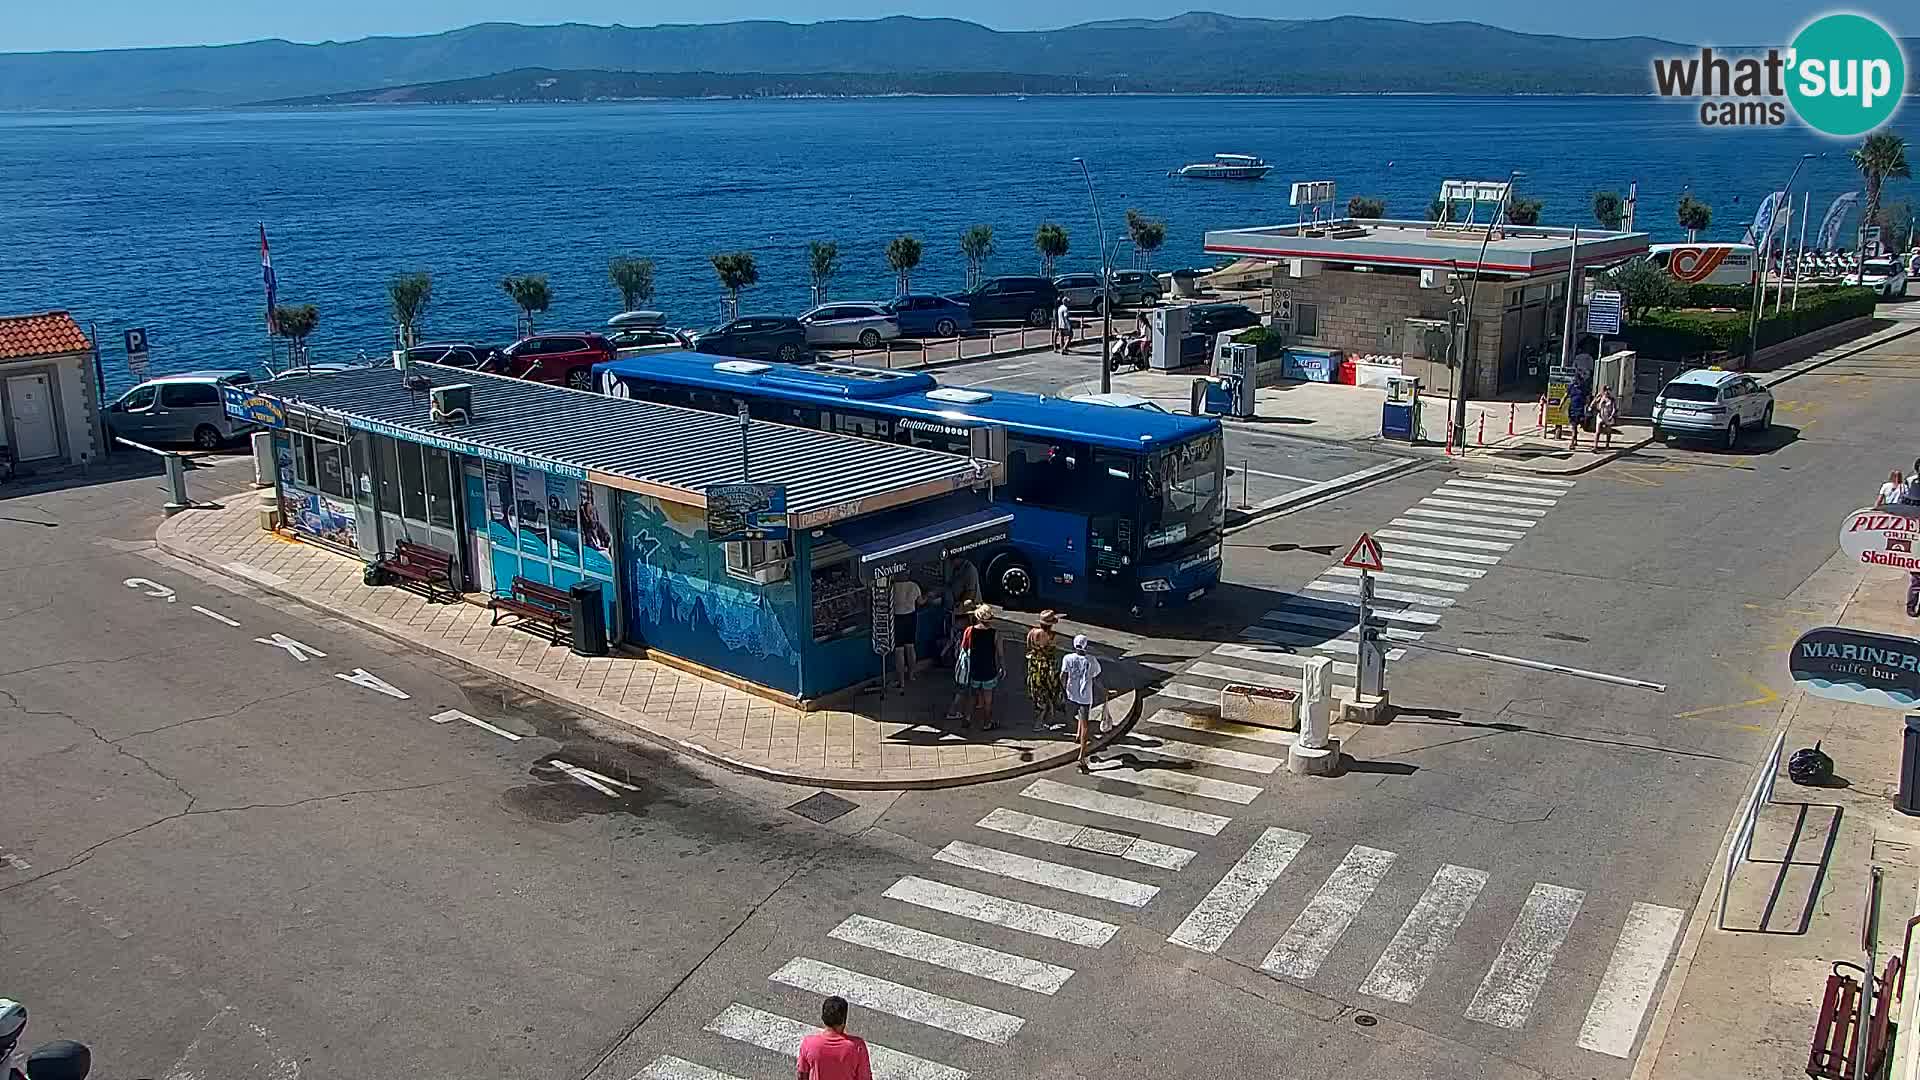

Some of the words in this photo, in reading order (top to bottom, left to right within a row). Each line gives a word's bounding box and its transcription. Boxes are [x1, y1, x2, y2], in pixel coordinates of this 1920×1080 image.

[130, 332, 142, 350] P
[478, 447, 492, 459] BUS
[493, 451, 526, 466] STATION
[528, 458, 553, 472] TICKET
[555, 463, 583, 478] OFFICE
[1849, 515, 1920, 533] PIZZE
[1883, 530, 1919, 541] GRILL
[1802, 642, 1920, 674] MARINER
[1830, 662, 1867, 676] caffe
[1871, 666, 1899, 681] bar
